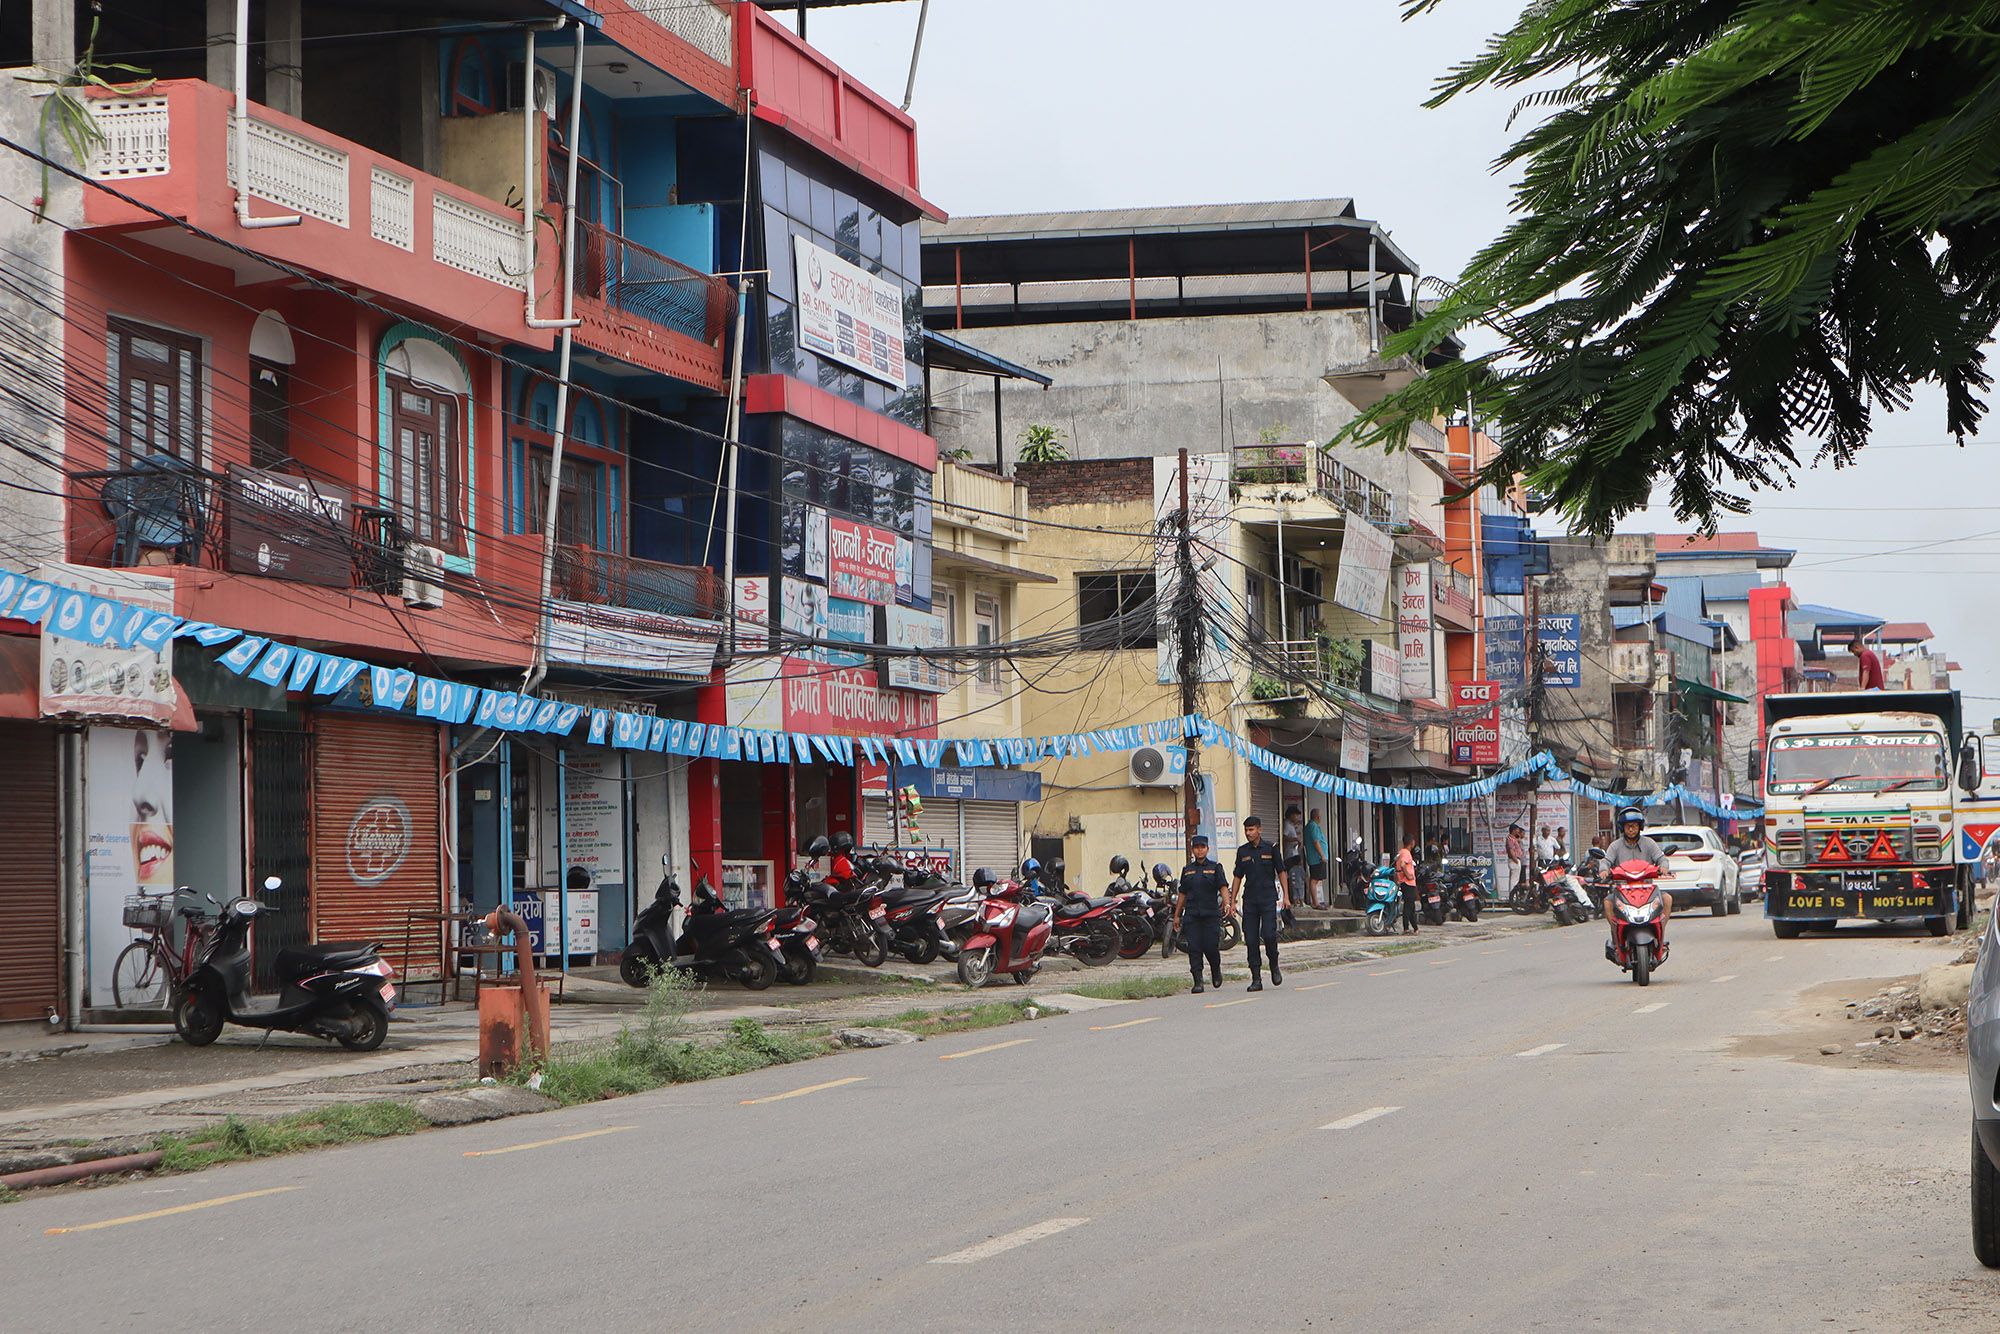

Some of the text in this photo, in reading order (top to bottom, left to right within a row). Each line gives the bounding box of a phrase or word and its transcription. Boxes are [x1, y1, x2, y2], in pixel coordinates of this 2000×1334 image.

[866, 529, 896, 572] डेन्टल
[1402, 591, 1425, 609] डेन्टल
[1460, 685, 1492, 700] नव
[1455, 725, 1497, 743] क्लिनिक
[1141, 815, 1184, 829] प्रयोगशा
[1844, 816, 1870, 824] TAA
[1788, 895, 1934, 908] LOVE IS NOT'S LIFE
